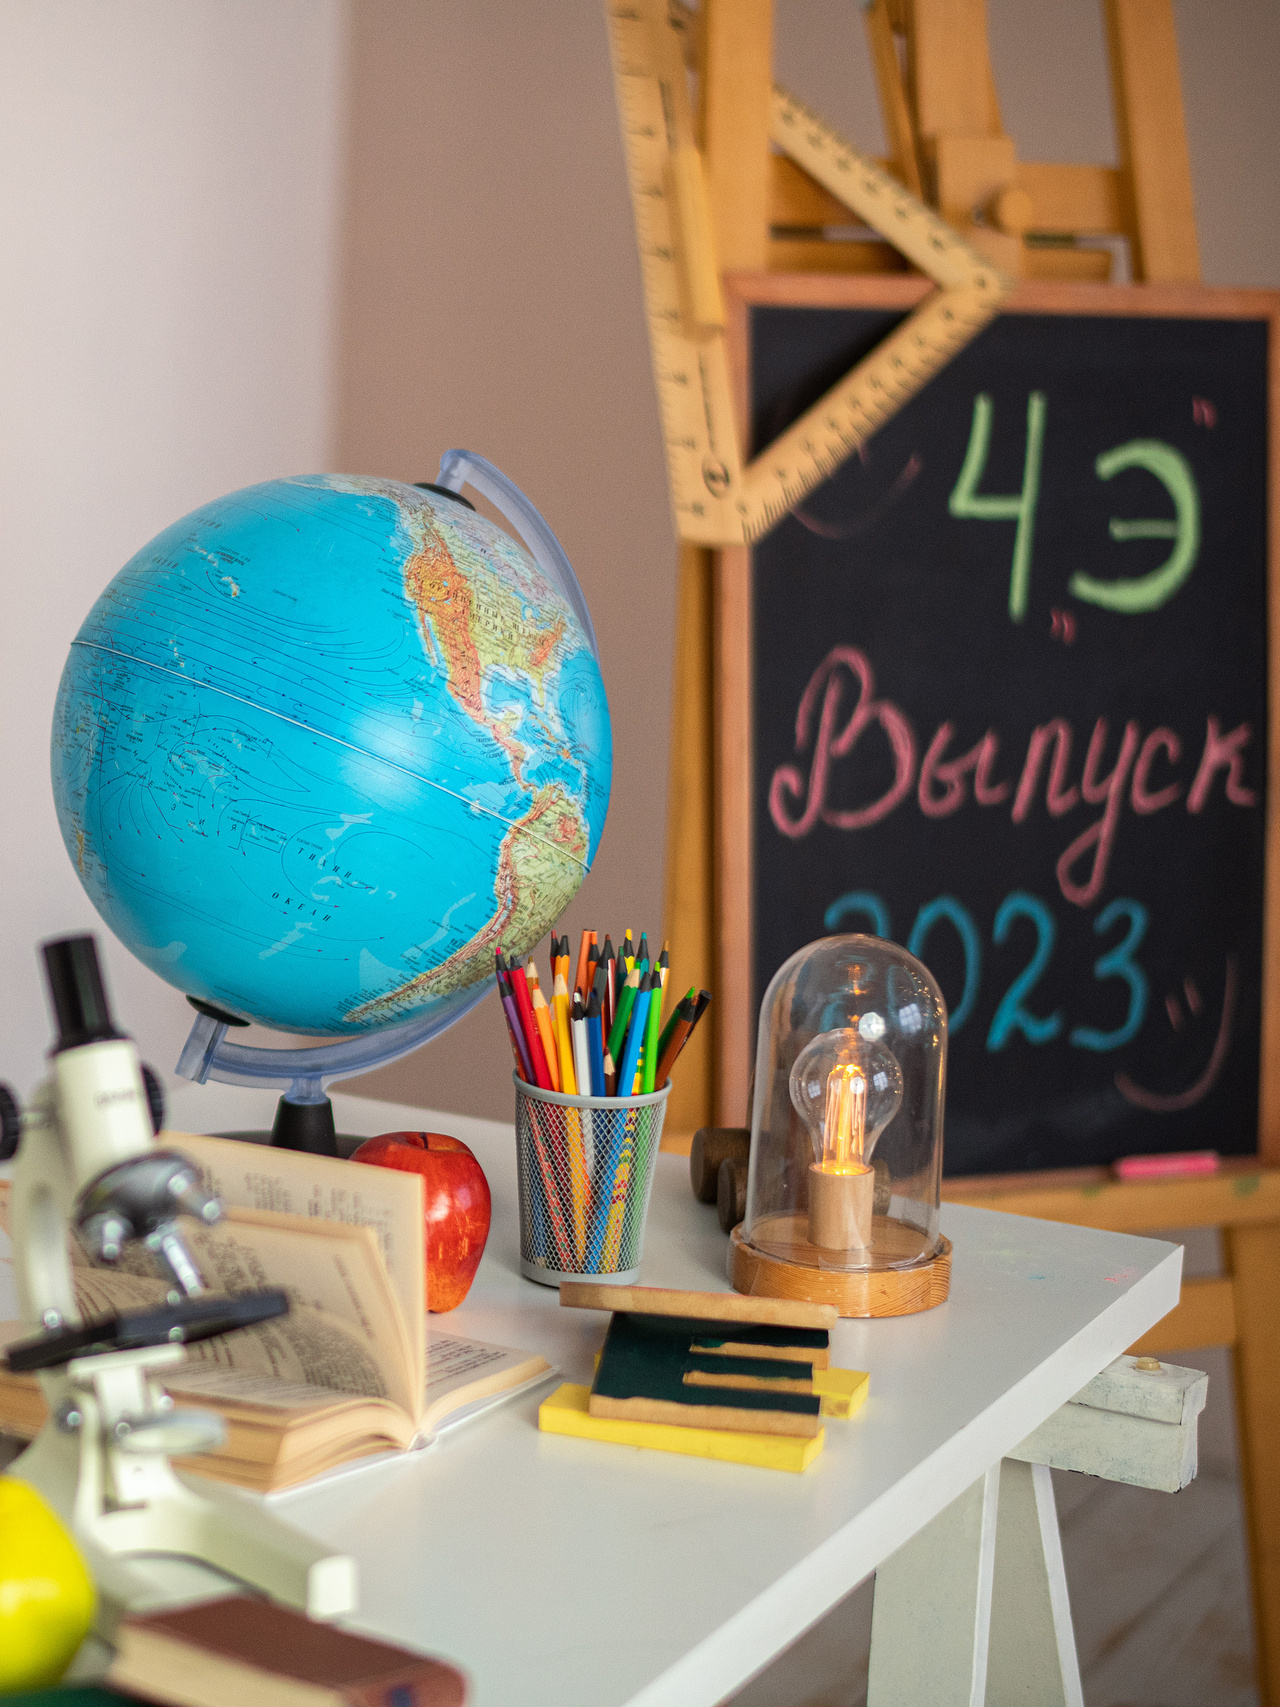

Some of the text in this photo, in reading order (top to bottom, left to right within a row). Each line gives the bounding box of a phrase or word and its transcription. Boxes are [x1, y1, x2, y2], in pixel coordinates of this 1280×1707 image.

[948, 389, 1047, 623] 4
[769, 645, 1256, 907] Выпуск
[272, 892, 331, 922] ОКЕАН
[298, 847, 352, 879] ТИХИЙ
[824, 891, 1148, 1053] 2023
